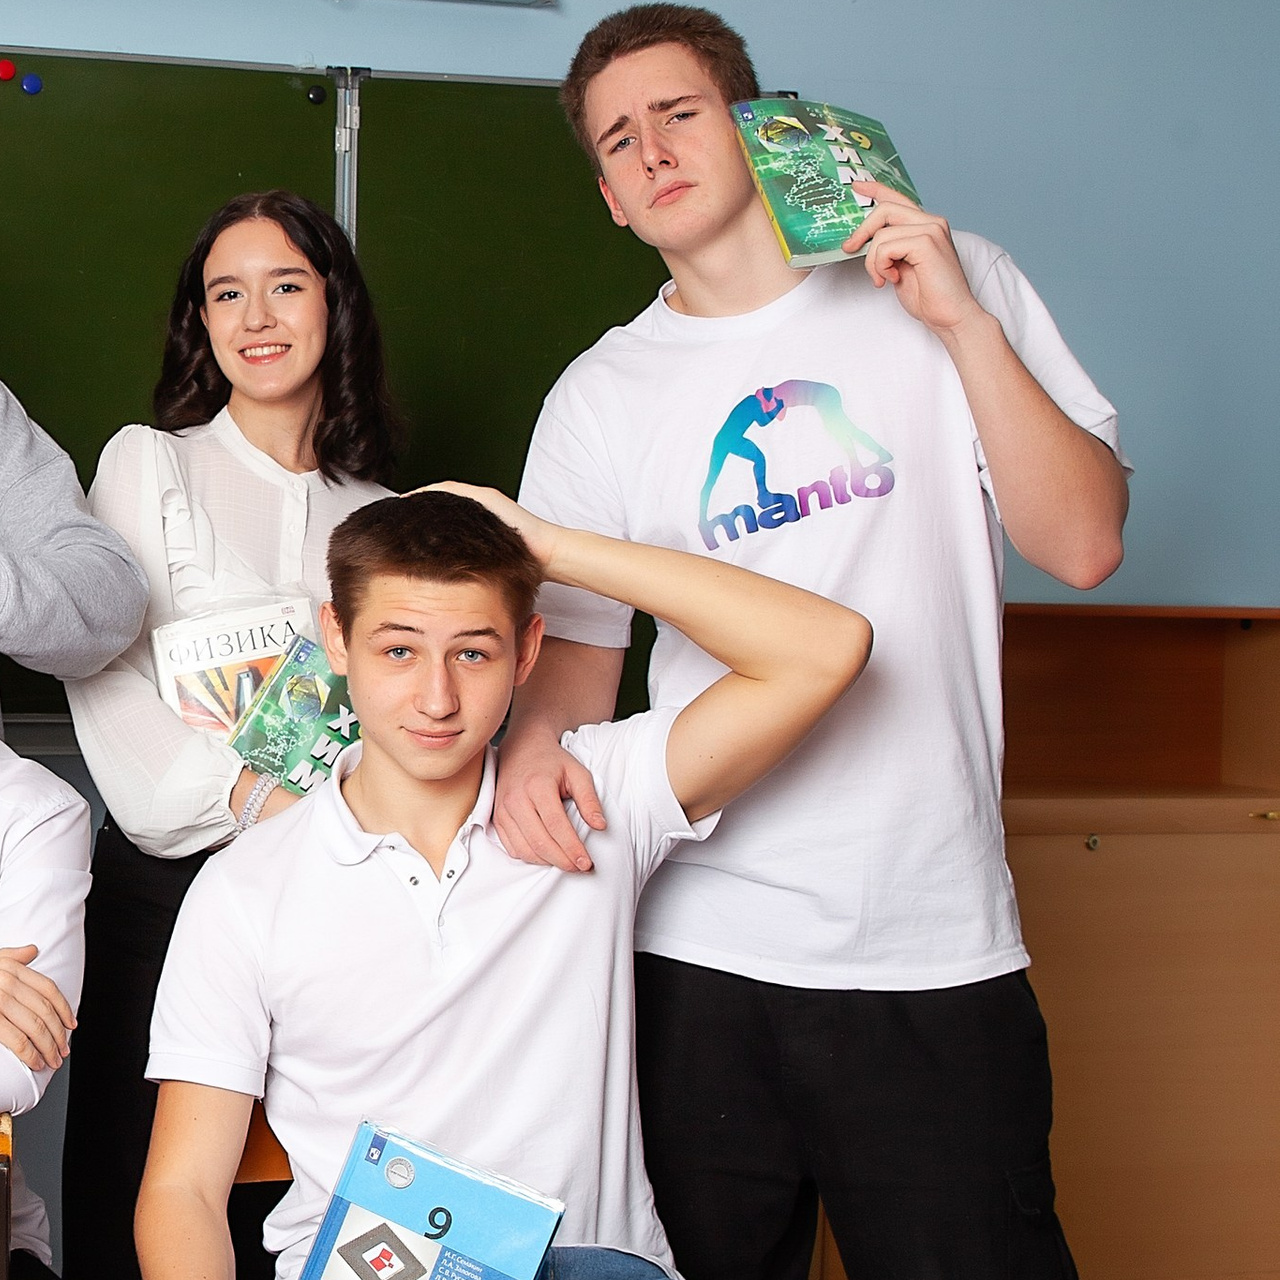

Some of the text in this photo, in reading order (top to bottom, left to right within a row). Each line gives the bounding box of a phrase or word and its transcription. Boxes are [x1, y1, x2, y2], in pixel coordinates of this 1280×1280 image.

[849, 131, 872, 150] 9
[698, 464, 896, 552] manto
[168, 620, 297, 665] ФИЗИКА
[423, 1206, 453, 1240] 9
